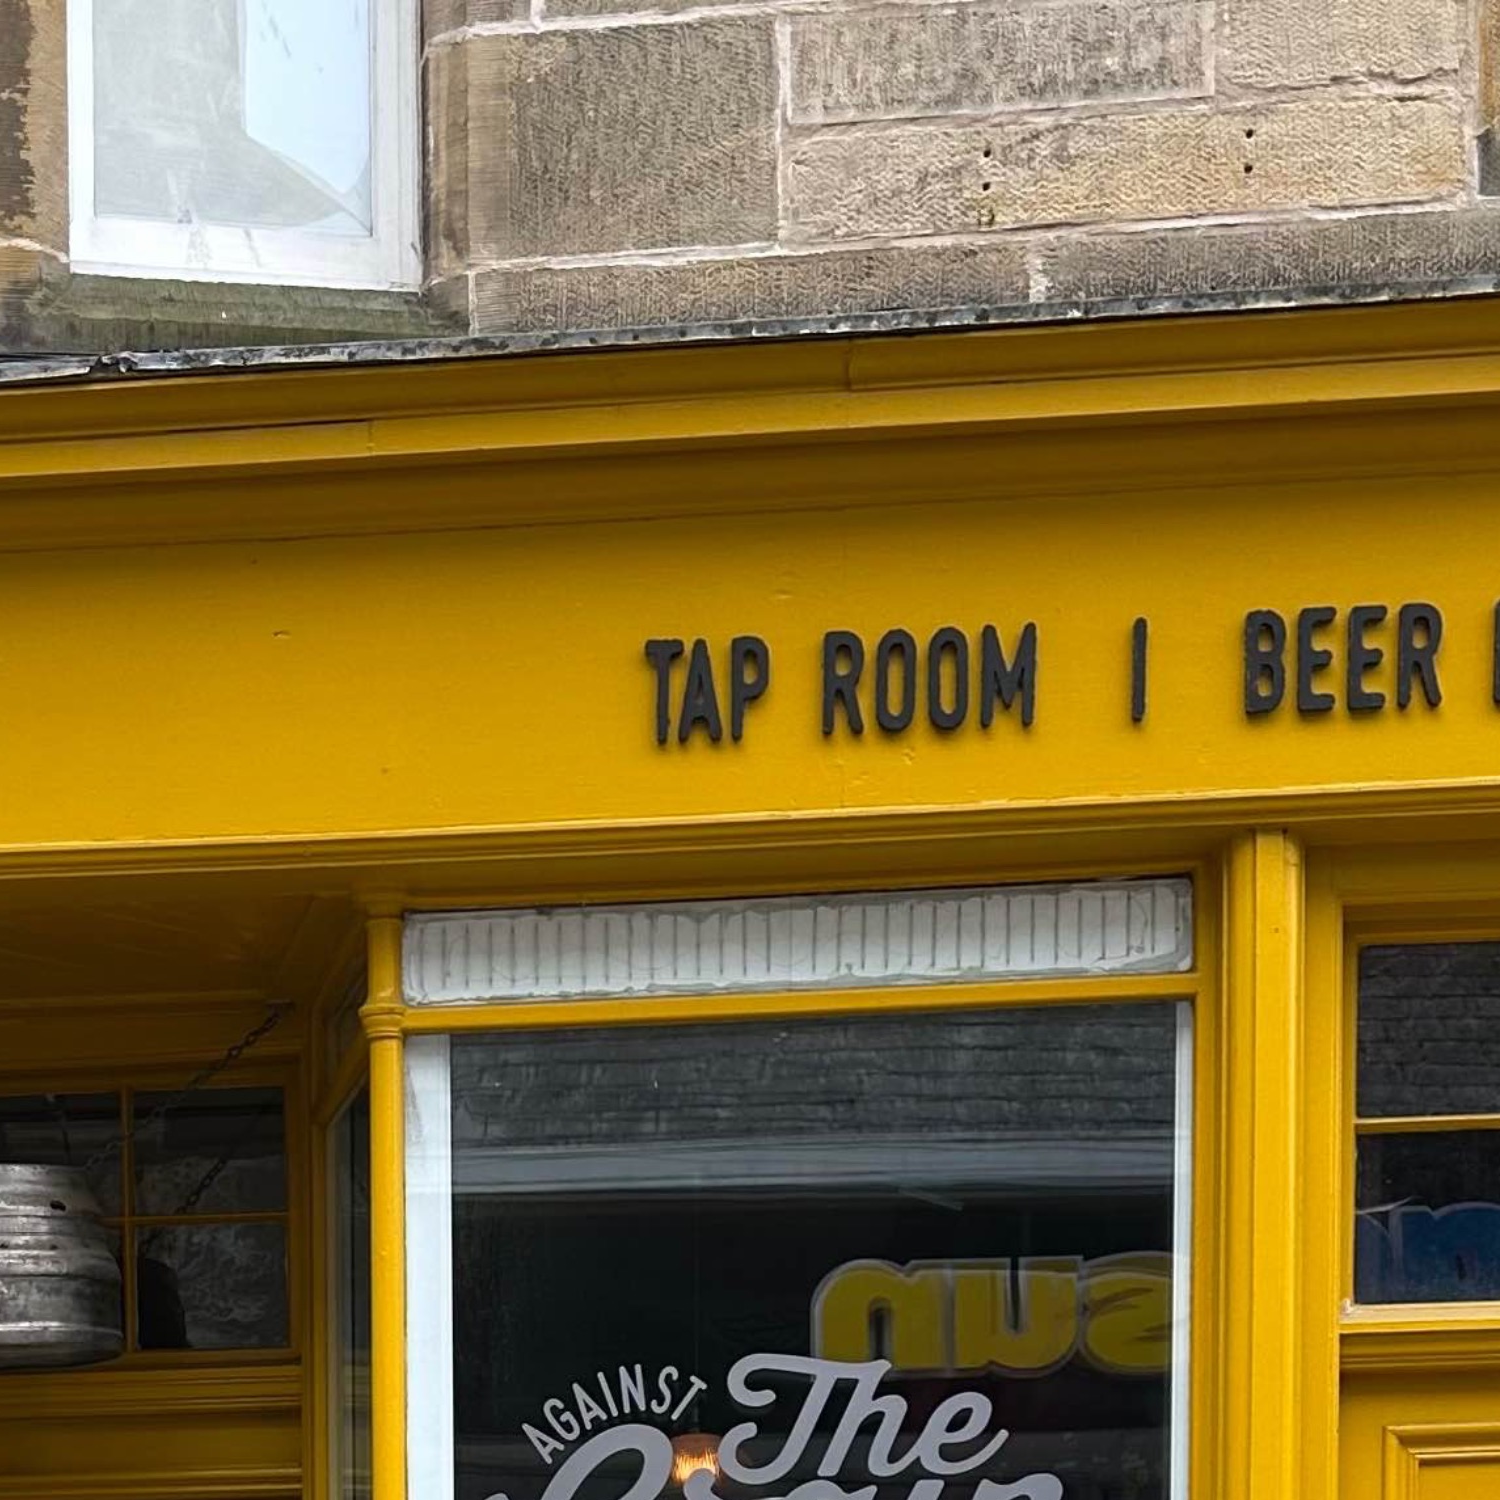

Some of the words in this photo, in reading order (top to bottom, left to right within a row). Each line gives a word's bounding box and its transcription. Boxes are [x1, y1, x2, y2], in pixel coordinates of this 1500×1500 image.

[645, 635, 770, 746] TAP
[822, 621, 1038, 736] ROOM
[1245, 603, 1443, 715] BEER
[521, 1363, 708, 1465] AGAINST
[716, 1352, 1009, 1486] The
